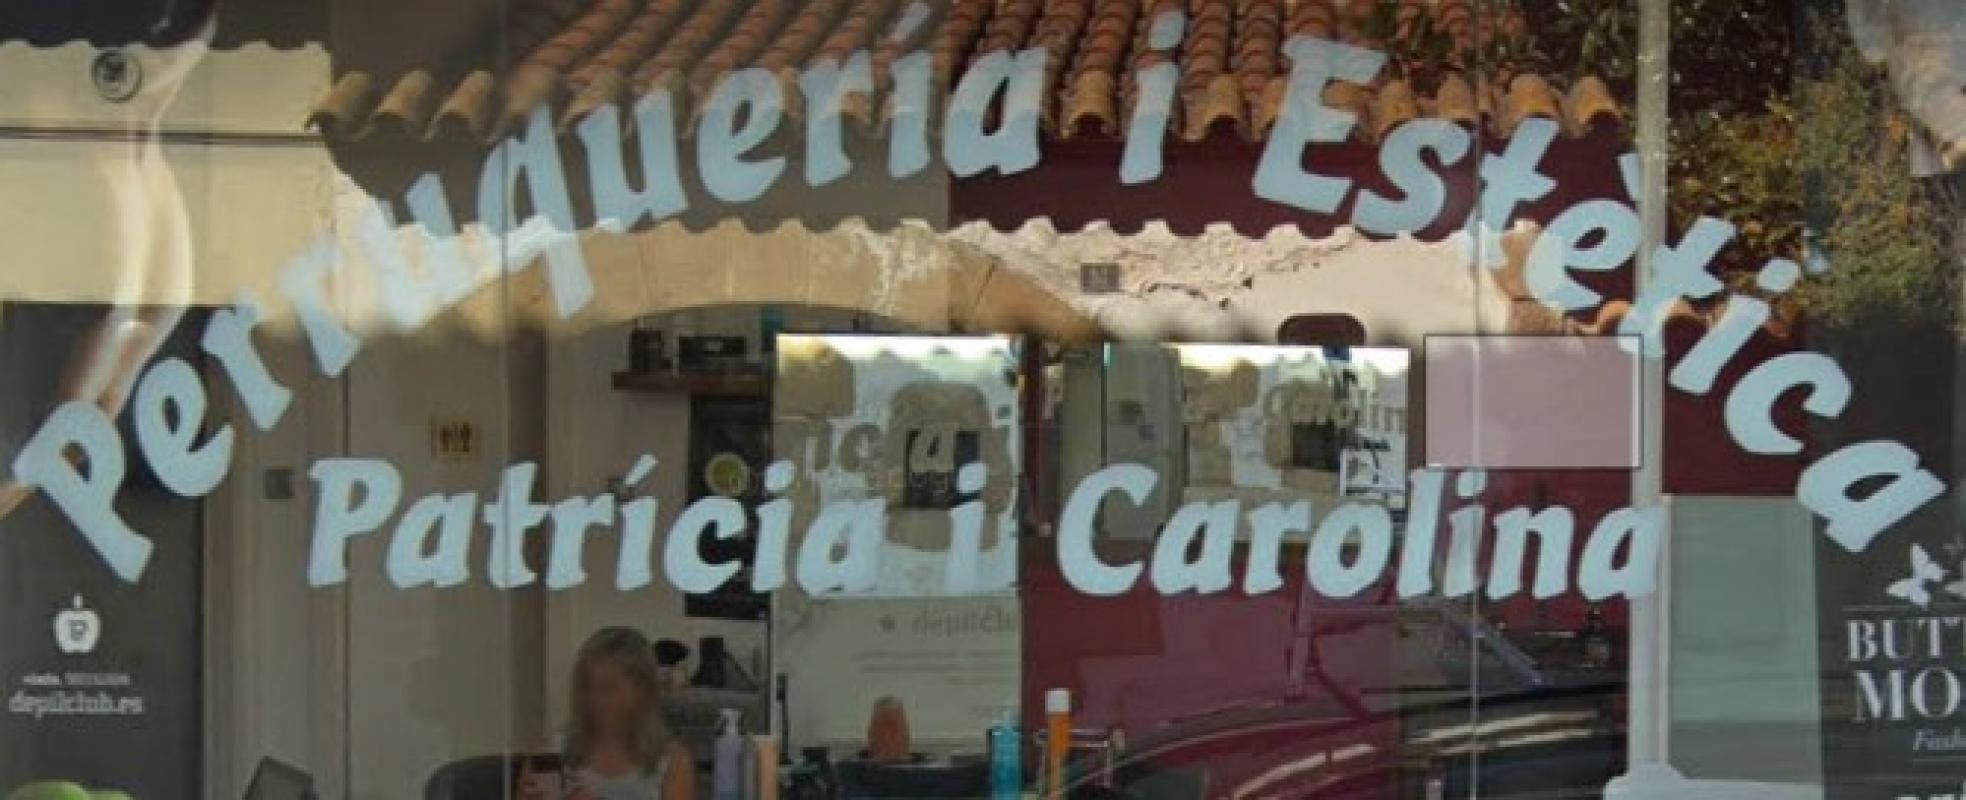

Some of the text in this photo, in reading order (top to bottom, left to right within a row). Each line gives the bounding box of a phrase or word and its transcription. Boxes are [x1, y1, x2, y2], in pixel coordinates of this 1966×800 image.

[12, 2, 1946, 583] Perruquería i Estètica
[307, 453, 1664, 602] Patrícia i Carolina
